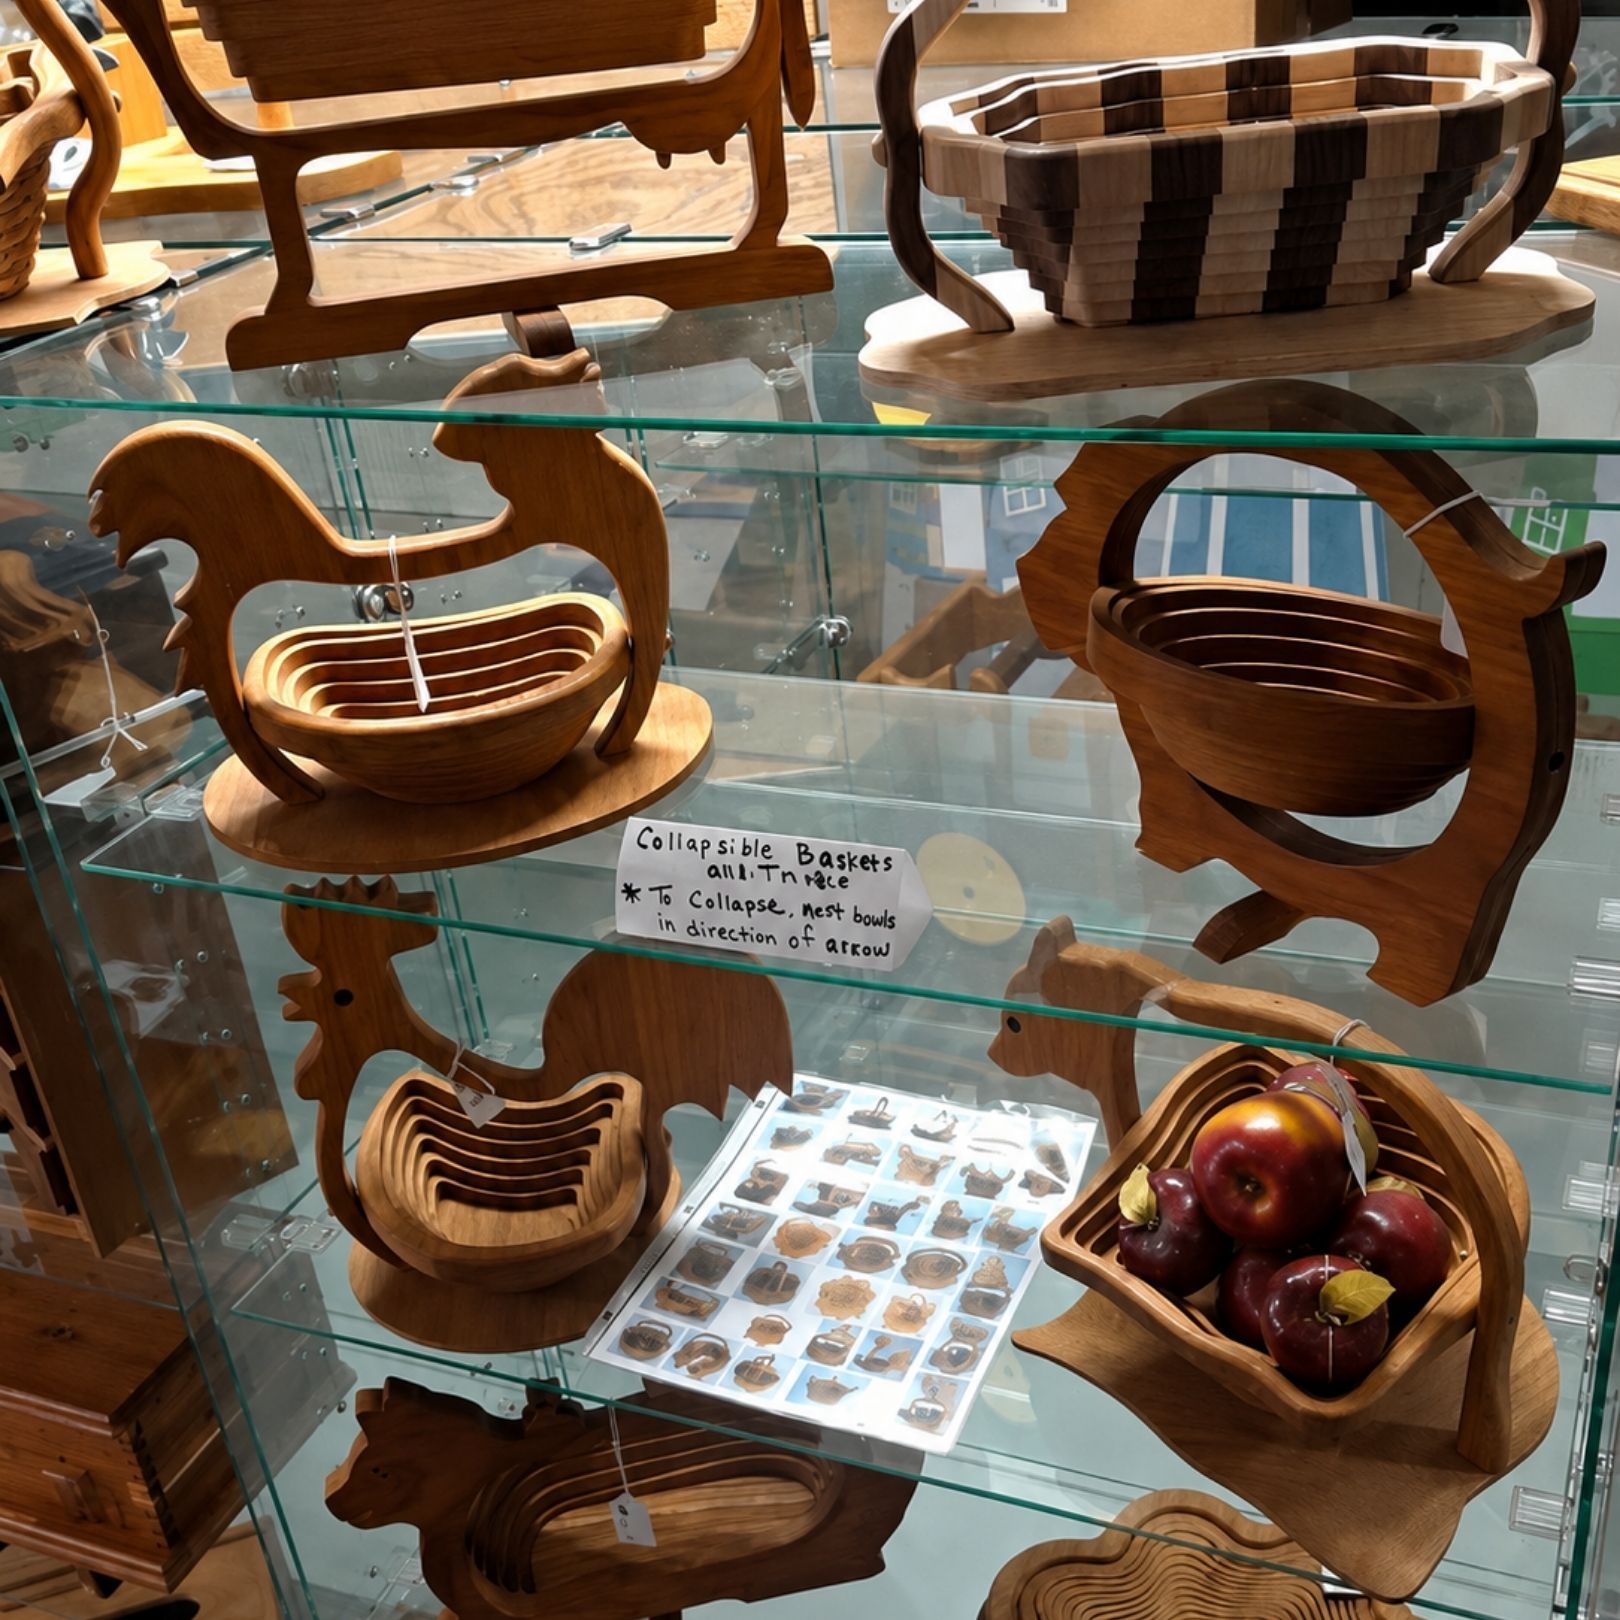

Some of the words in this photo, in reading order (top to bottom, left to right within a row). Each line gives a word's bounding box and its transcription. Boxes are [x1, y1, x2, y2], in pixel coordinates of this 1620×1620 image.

[636, 825, 774, 861] Collapsible
[796, 842, 893, 873] Baskets
[648, 884, 673, 906] To
[689, 889, 794, 919] Collapse,
[802, 902, 845, 921] nest
[853, 905, 896, 930] bowls
[657, 911, 677, 933] in
[686, 919, 777, 945] direction
[788, 923, 816, 949] of
[825, 937, 891, 958] arrow
